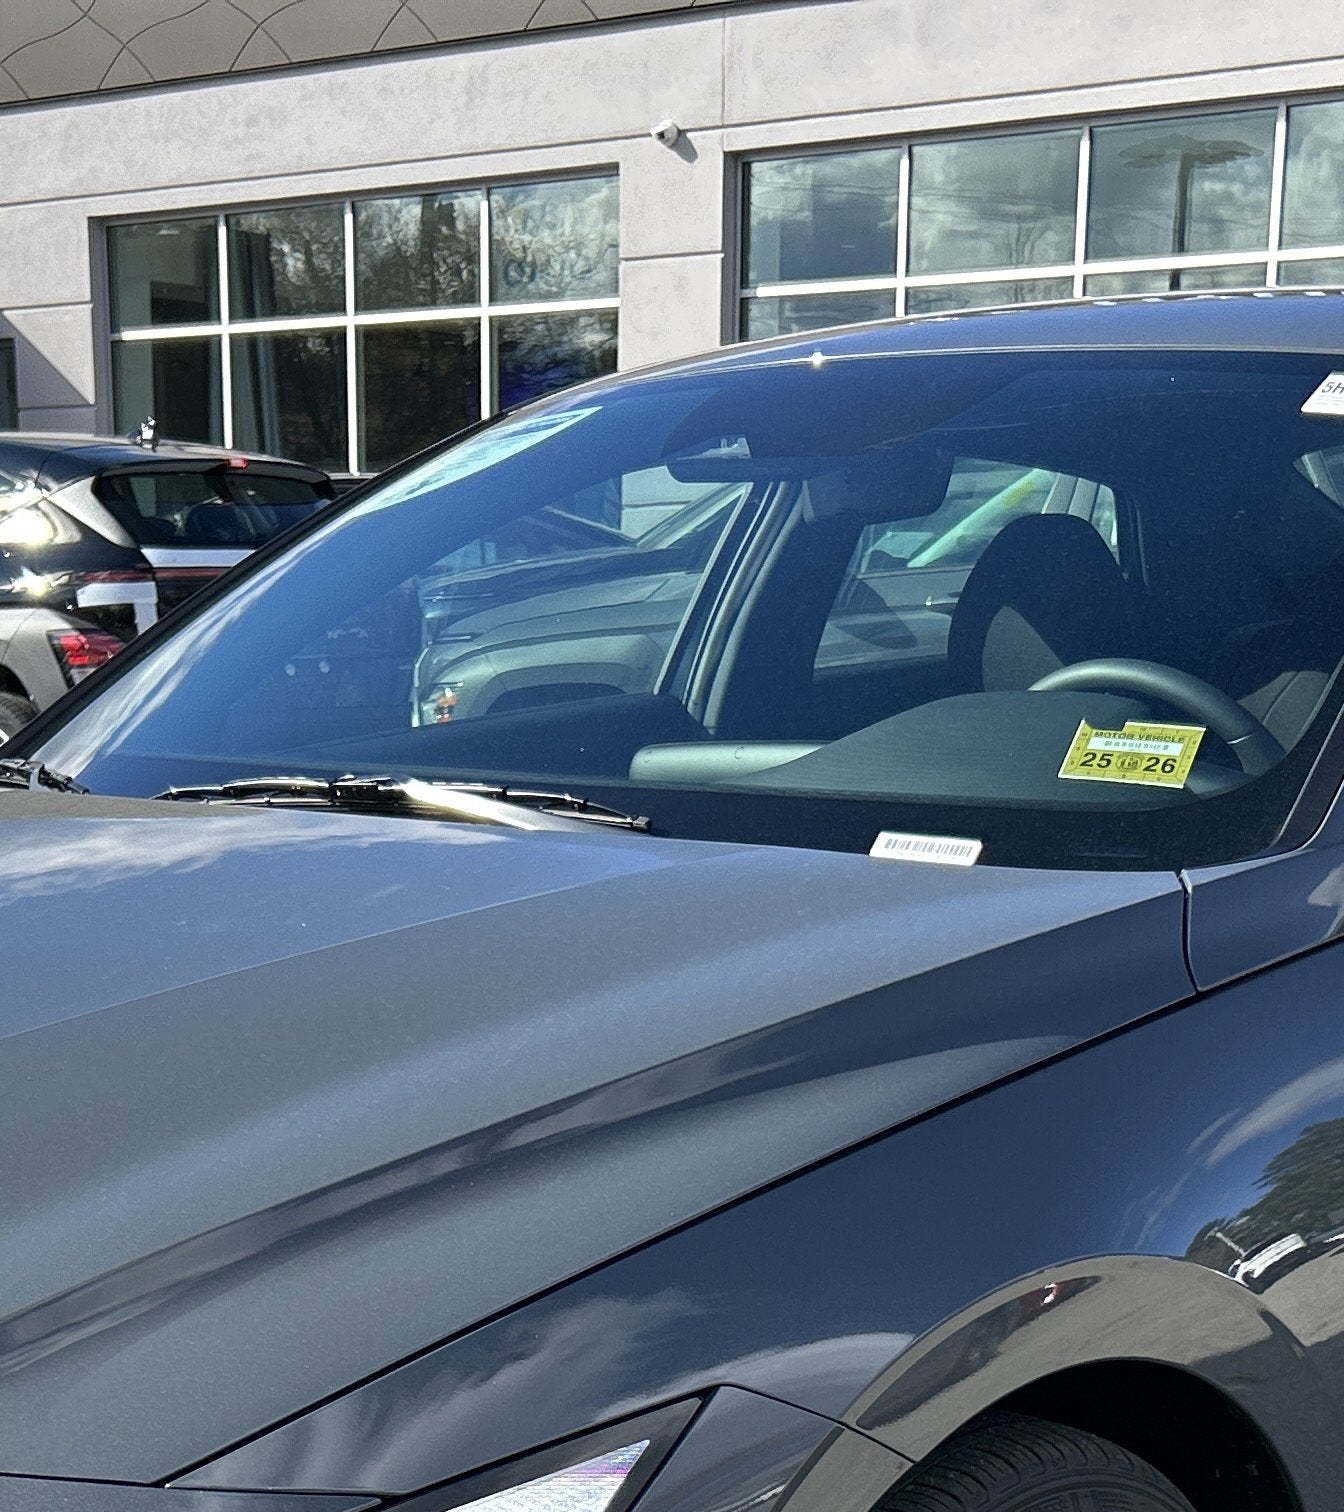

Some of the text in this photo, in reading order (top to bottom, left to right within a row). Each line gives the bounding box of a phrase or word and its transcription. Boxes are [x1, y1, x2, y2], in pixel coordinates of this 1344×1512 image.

[1094, 731, 1185, 743] MOTOR VEHICLE
[1079, 751, 1177, 774] 25 26
